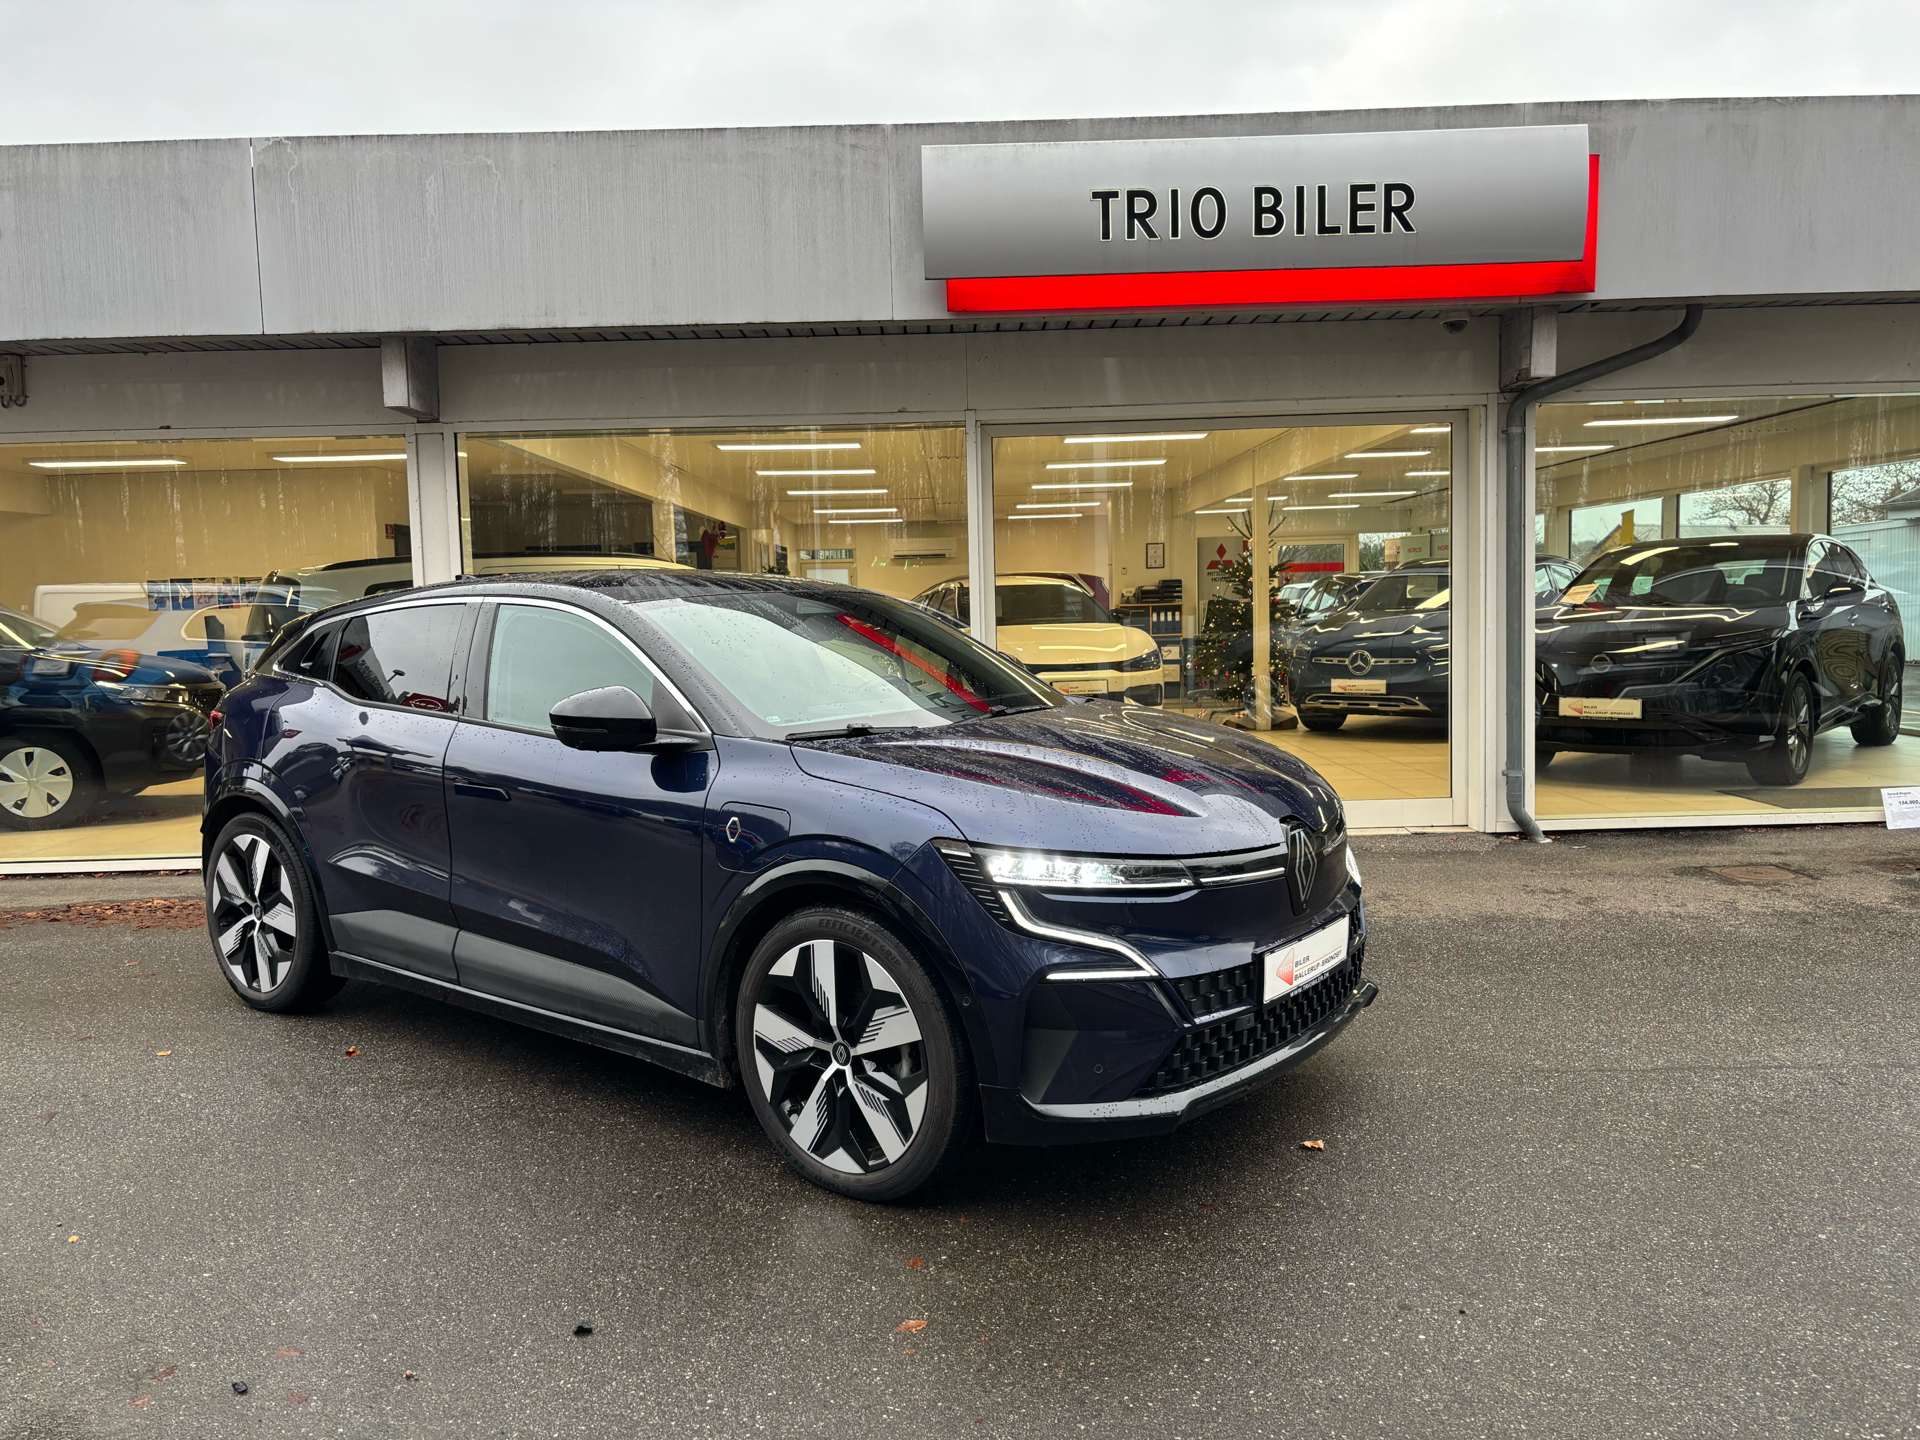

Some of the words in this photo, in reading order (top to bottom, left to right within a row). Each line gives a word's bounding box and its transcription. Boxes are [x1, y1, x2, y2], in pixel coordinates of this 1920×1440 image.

[1090, 184, 1228, 241] TRIO
[1252, 182, 1418, 238] BILER
[818, 918, 879, 947] EFFICIENT
[1279, 963, 1293, 975] TRIO
[1294, 955, 1310, 968] BILER
